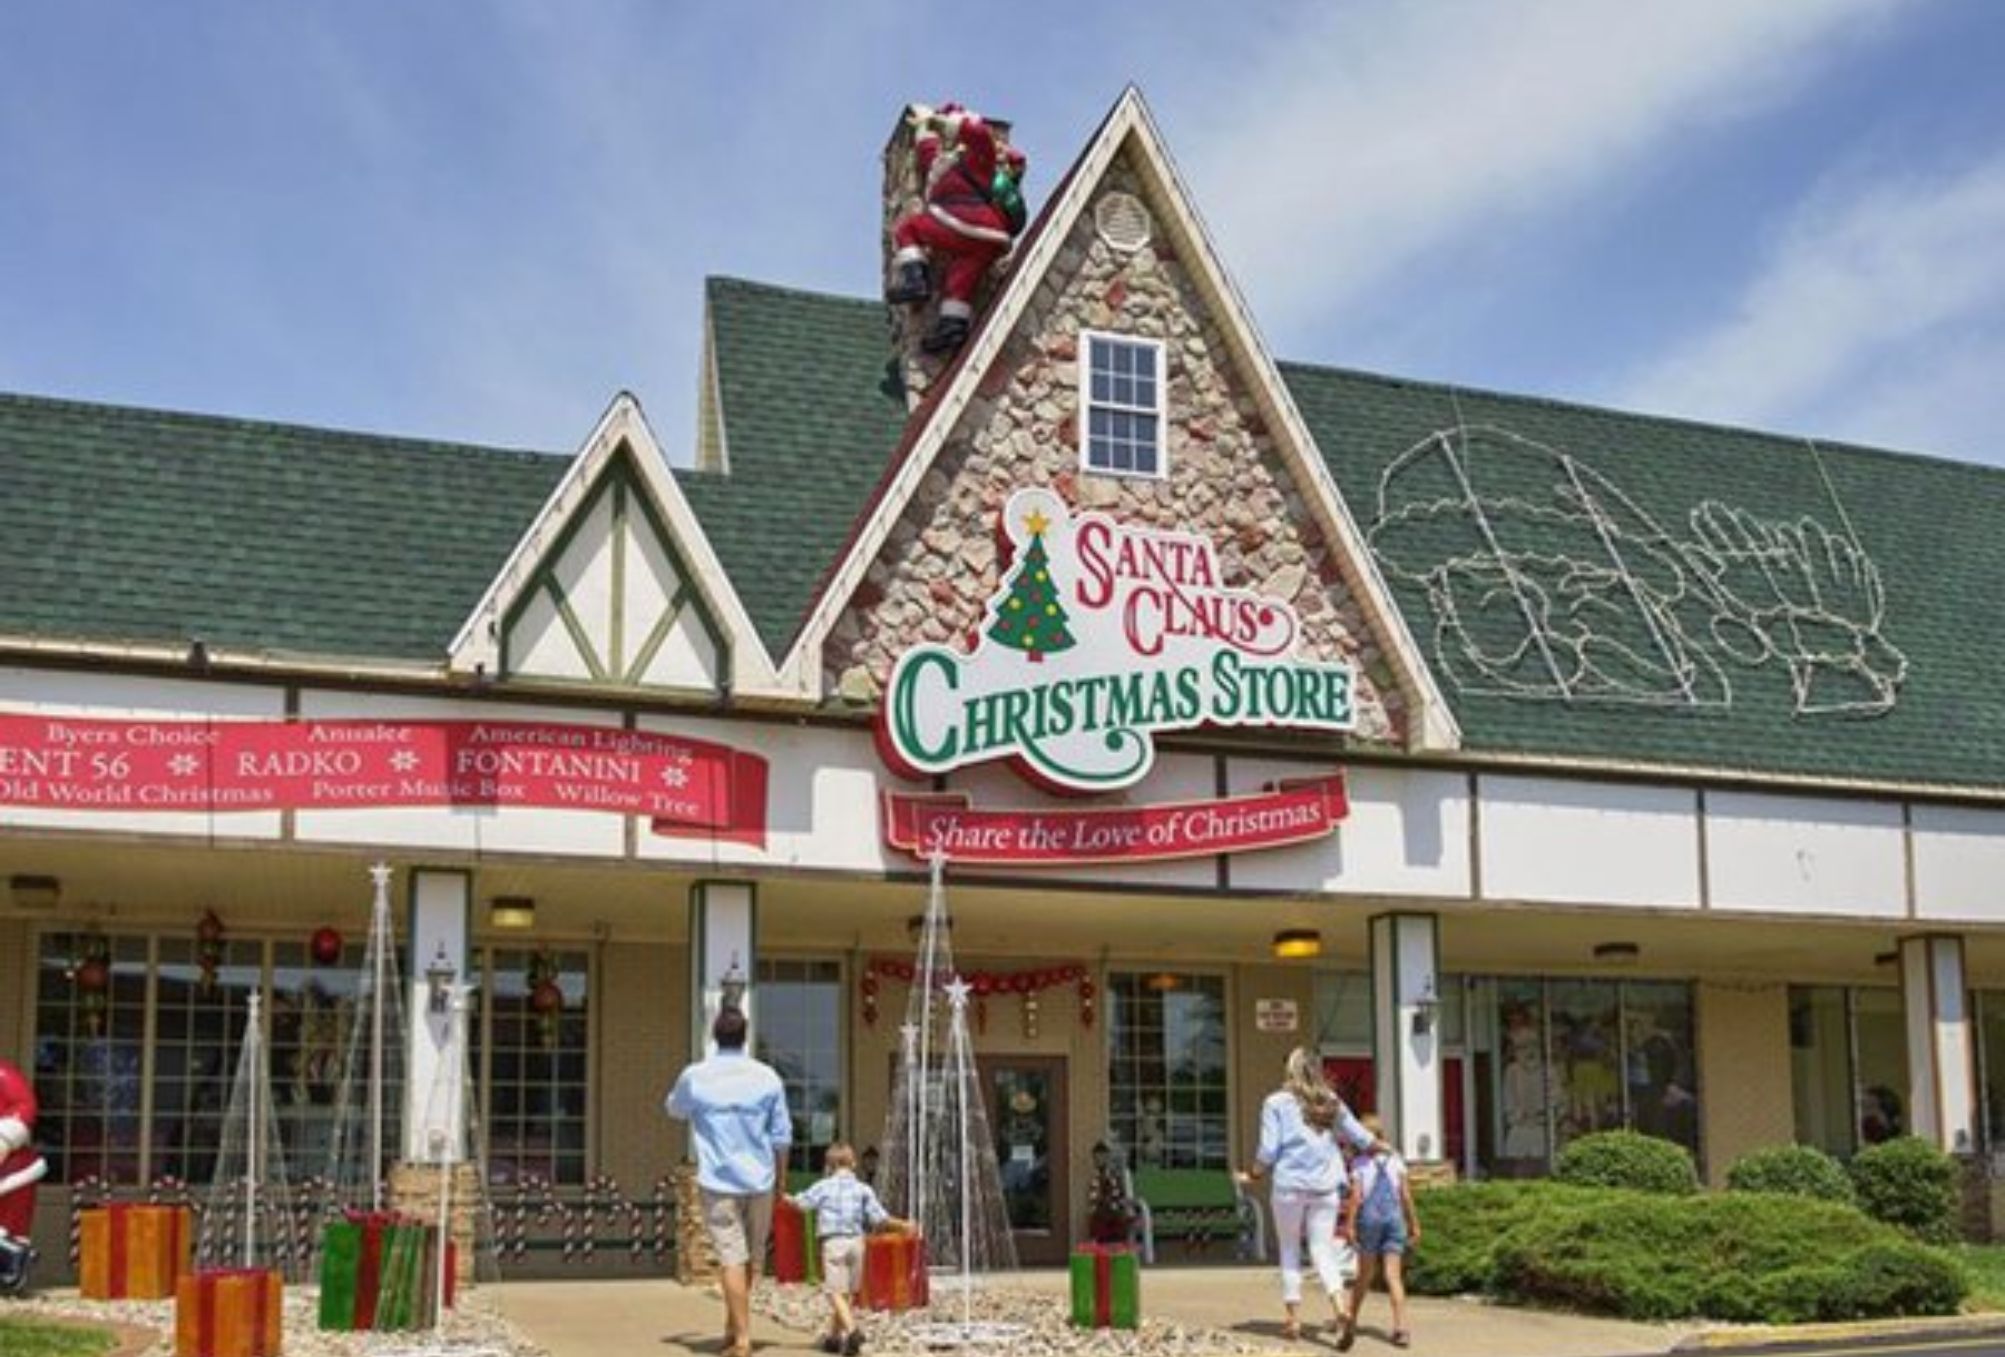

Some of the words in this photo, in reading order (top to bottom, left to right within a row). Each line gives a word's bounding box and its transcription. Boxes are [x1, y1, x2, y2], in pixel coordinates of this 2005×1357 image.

[1075, 521, 1214, 609] SANTA
[1123, 587, 1274, 656] CLAUS
[893, 649, 1201, 781] CHRISTMAS
[1212, 649, 1352, 722] STORE
[0, 747, 81, 777] ENT
[91, 751, 131, 781] 56
[237, 751, 362, 777] RADKO
[456, 748, 640, 783] FONTANINI
[125, 724, 220, 746] Choice
[469, 725, 586, 748] American
[593, 730, 693, 766] Lighting
[48, 783, 132, 803] World
[138, 784, 272, 804] Christmas
[313, 780, 391, 800] Porter
[479, 778, 527, 799] Box
[554, 781, 640, 807] Willow
[645, 791, 700, 815] Tree
[926, 814, 1012, 851] Share
[1017, 816, 1067, 850] the
[1072, 818, 1141, 849] Love
[1148, 813, 1181, 845] of
[1183, 801, 1322, 842] Christmas
